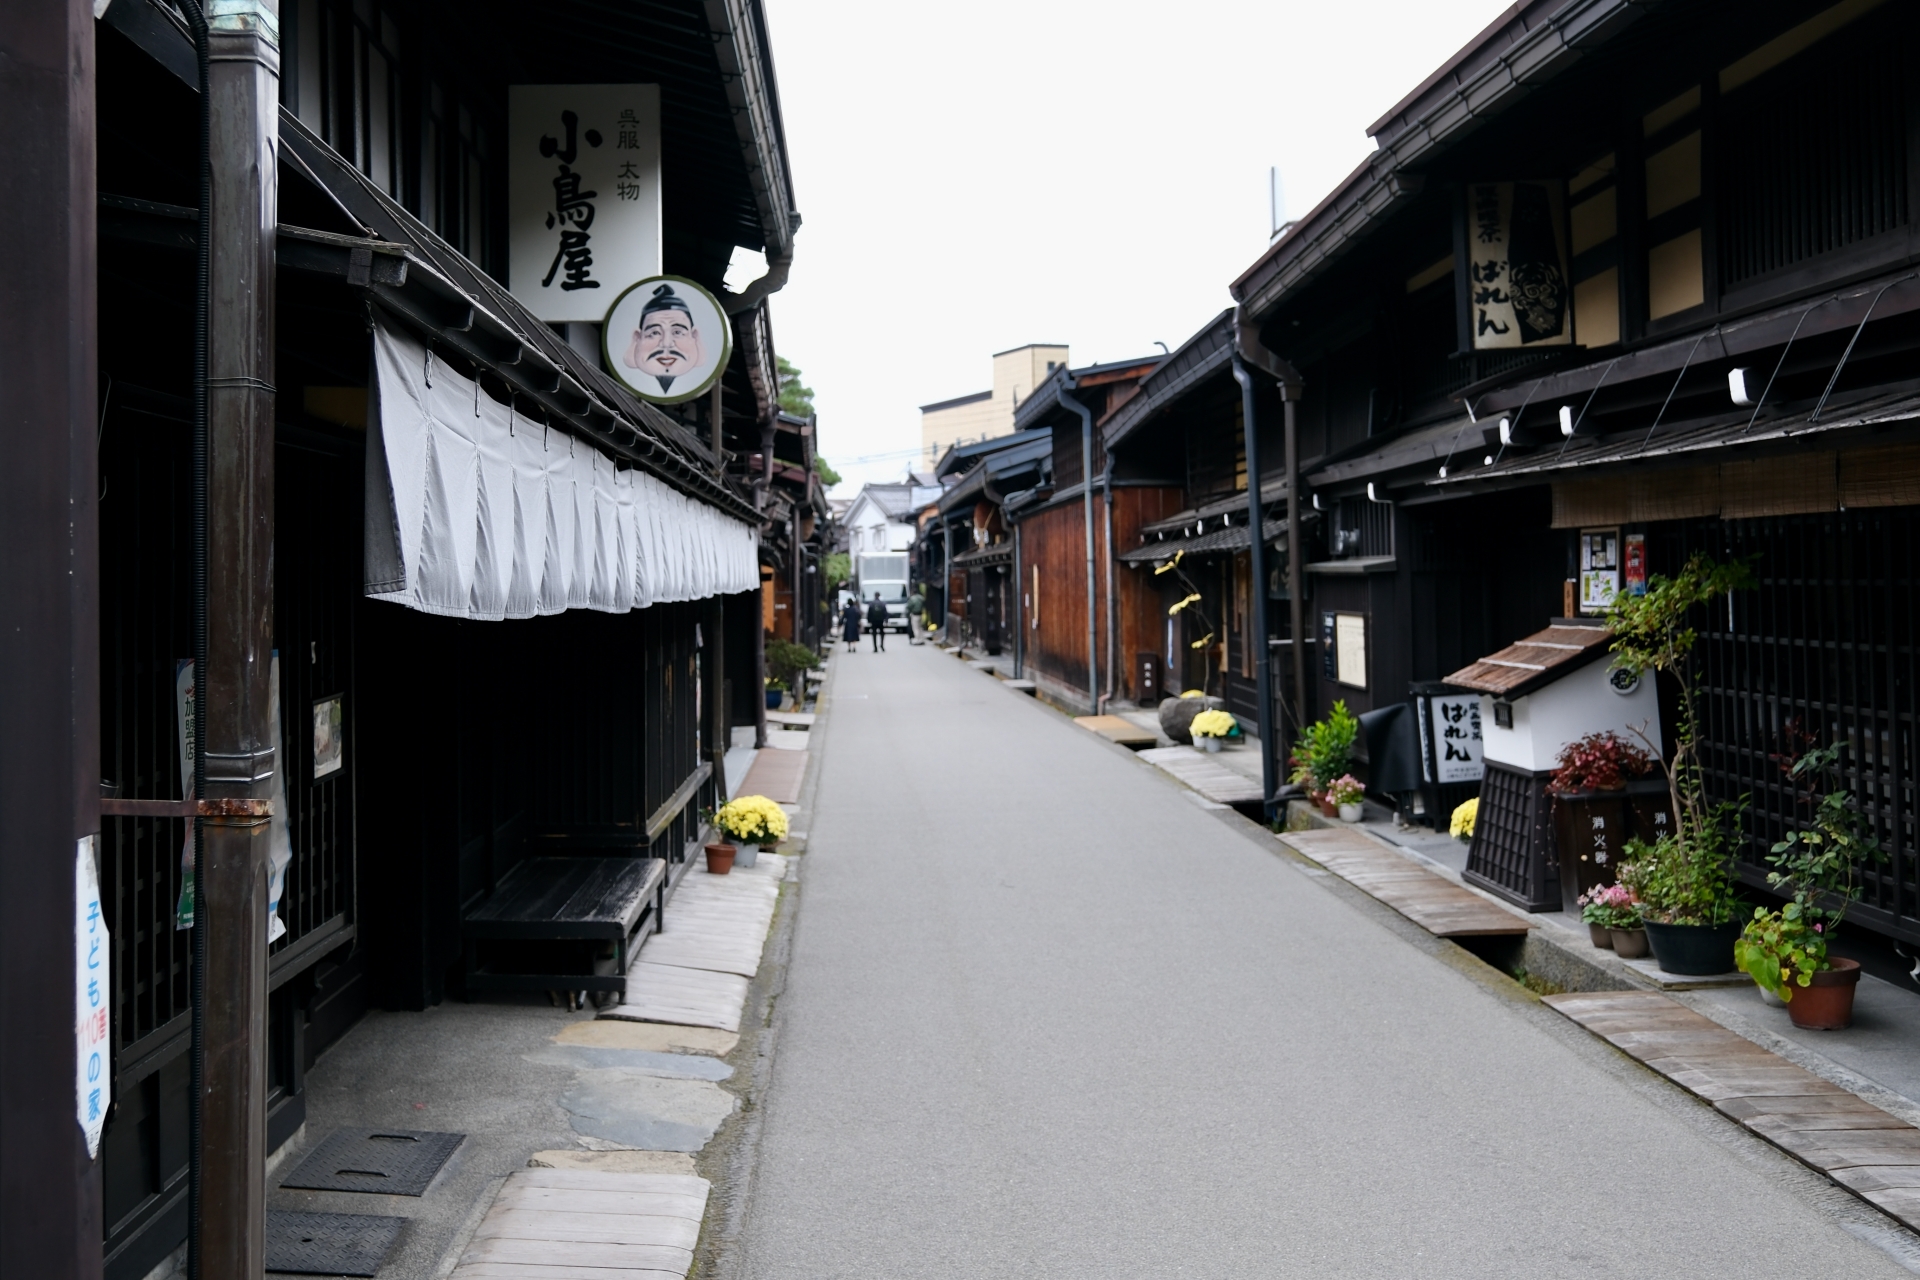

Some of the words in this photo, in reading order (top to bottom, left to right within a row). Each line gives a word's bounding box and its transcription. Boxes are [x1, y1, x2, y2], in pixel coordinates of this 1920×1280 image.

[539, 110, 603, 291] 小鳥屋
[617, 160, 640, 201] 太物
[1472, 260, 1510, 336] ばれん
[1592, 816, 1607, 864] 消火器
